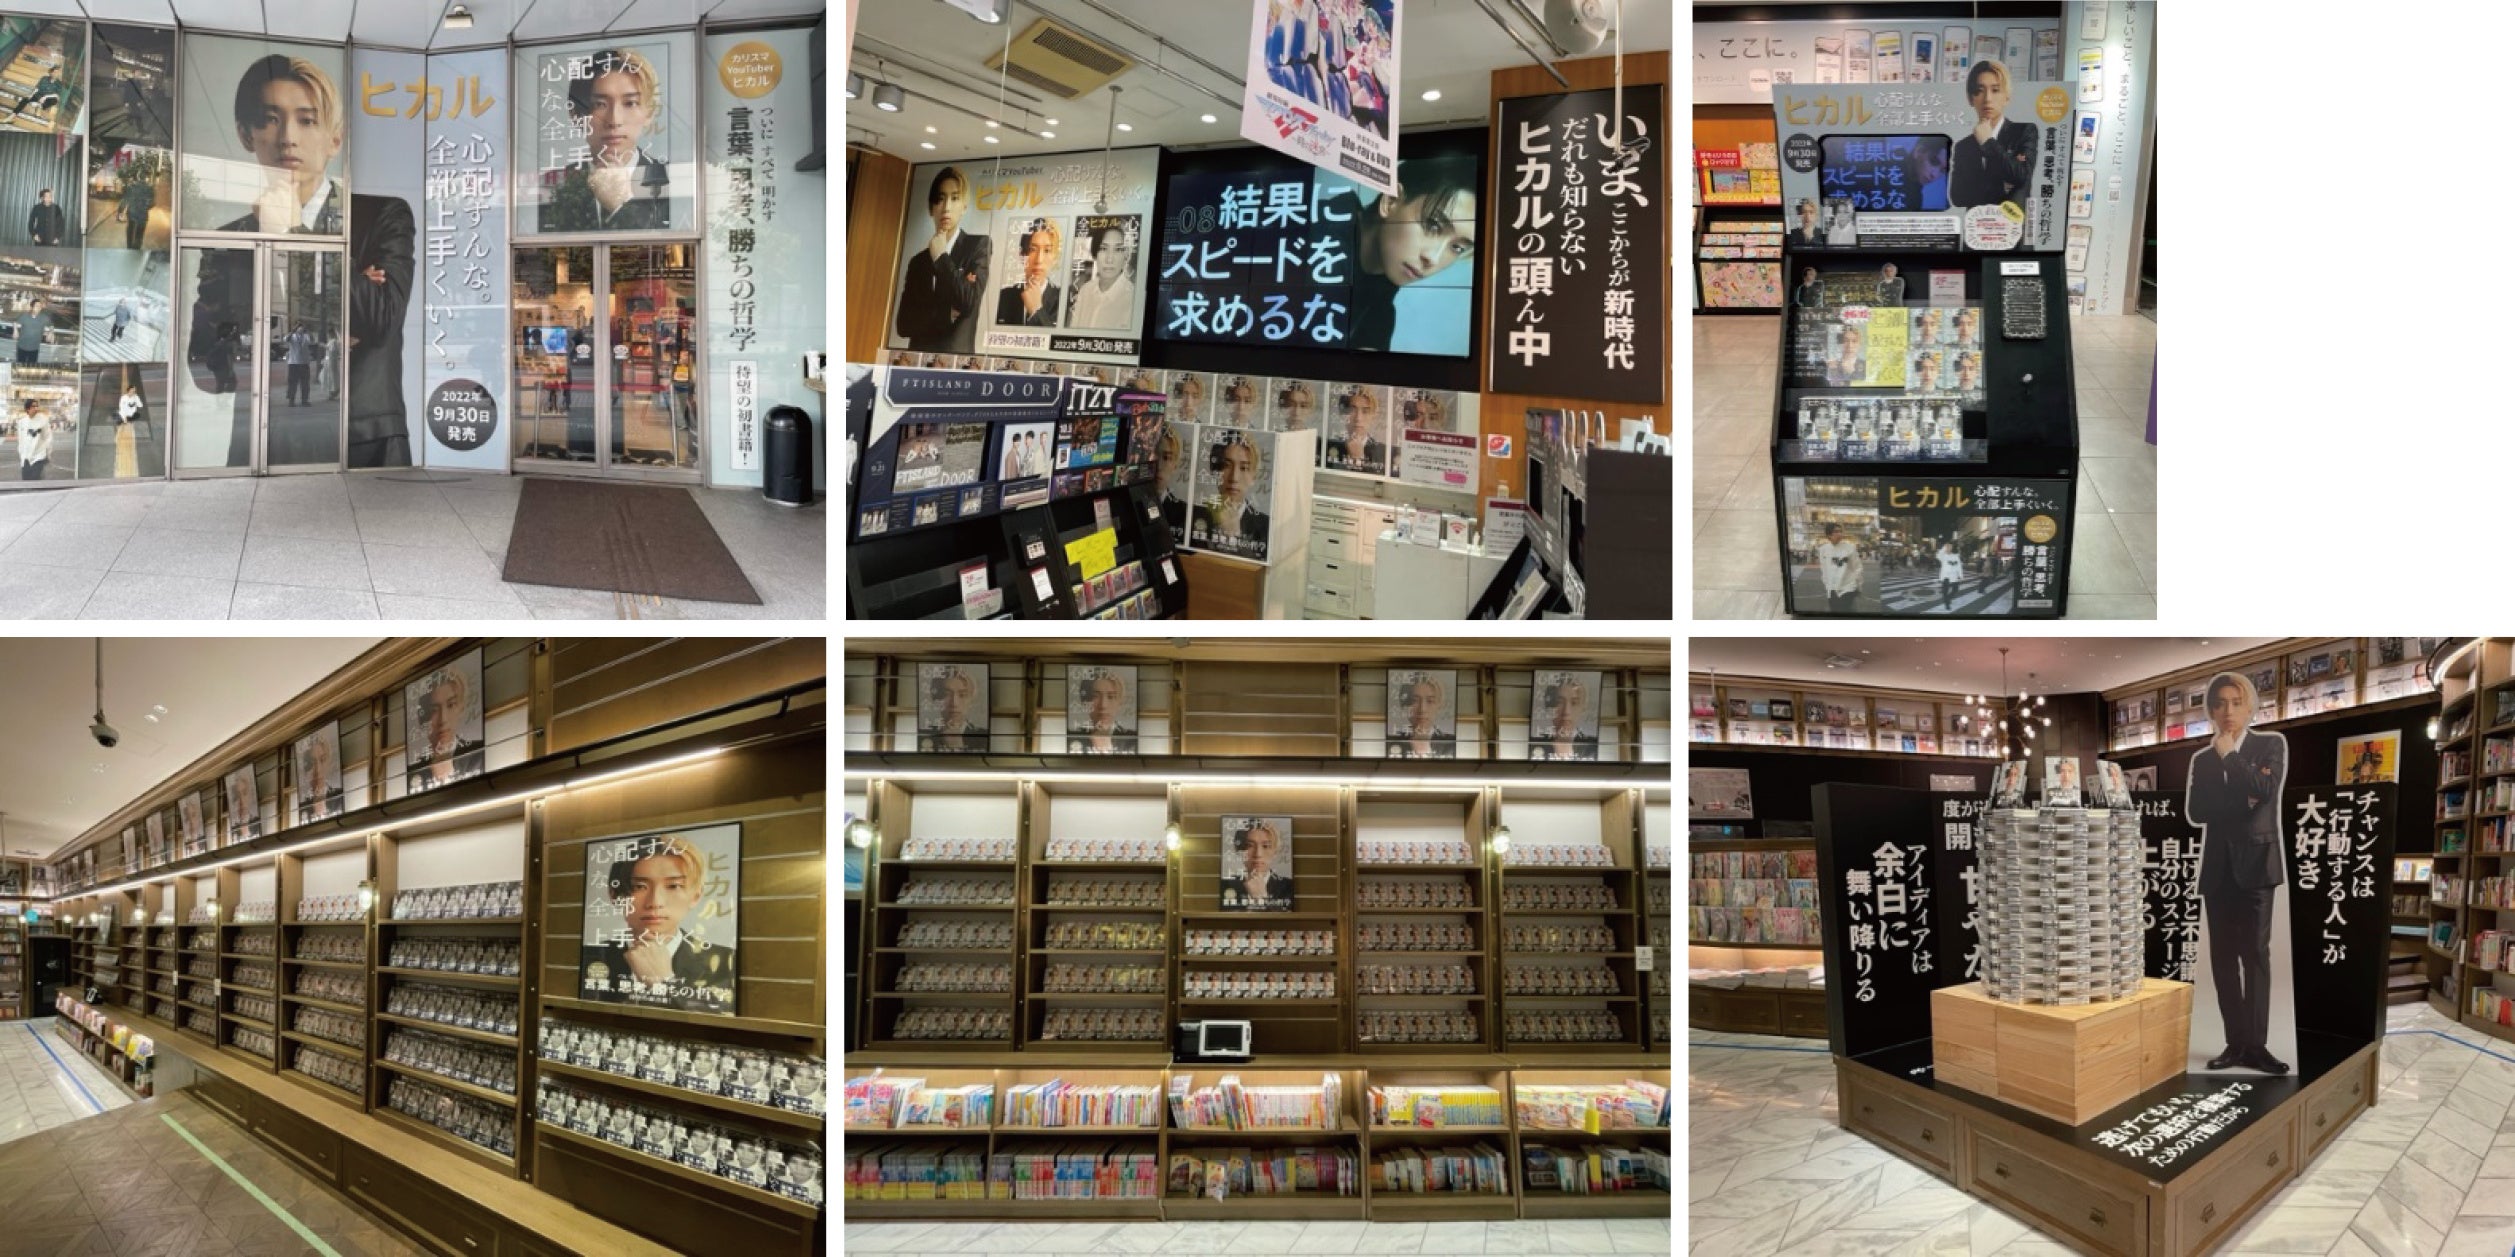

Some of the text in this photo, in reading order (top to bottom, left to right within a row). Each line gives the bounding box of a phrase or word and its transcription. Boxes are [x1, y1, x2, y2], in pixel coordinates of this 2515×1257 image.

[540, 52, 643, 82] 心配すん
[727, 65, 775, 75] YouTuber
[732, 53, 770, 63] カリスマ
[361, 71, 496, 121] ヒカル
[733, 76, 770, 88] ヒカル
[541, 88, 576, 112] な。
[1784, 94, 1873, 126] ヒカル
[540, 114, 594, 141] 全部
[540, 142, 669, 171] 上手くいく。
[1844, 141, 1905, 161] 結果に
[1822, 166, 1905, 186] スピードを
[975, 181, 1044, 211] ヒカル
[1218, 182, 1353, 231] 結果に
[1560, 117, 1588, 276] だれも知らない
[461, 132, 495, 303] 心配すんな。
[727, 107, 756, 352] 言葉、思考、勝ちの哲学
[1178, 206, 1216, 233] 08
[426, 134, 459, 371] 全部上手くいく。
[1508, 121, 1555, 367] ヒカルの頭ん中
[1161, 235, 1348, 284] スピードを
[1167, 291, 1347, 343] 求めるな
[441, 390, 483, 403] 2022年
[902, 378, 971, 389] FTISLAND
[980, 381, 1051, 397] DOOR
[1066, 383, 1118, 411] ITZY
[433, 406, 490, 423] 9月30日
[447, 425, 477, 443] 発売
[941, 467, 976, 486] DOOR
[1890, 486, 1970, 508] ヒカル
[1973, 485, 2039, 498] 心配すんな。
[590, 837, 688, 864] 心配すん
[2295, 793, 2328, 889] 大好き
[2352, 790, 2381, 898] チャンスは
[591, 873, 620, 889] な。
[698, 852, 734, 919] ヒカル
[2322, 791, 2354, 964] 「行動する人」が
[588, 897, 635, 919] 全部
[1872, 841, 1909, 951] 余白に
[1906, 845, 1933, 974] アイディアは
[585, 927, 712, 950] 上手くいく。
[1846, 869, 1876, 1002] 舞い降りる
